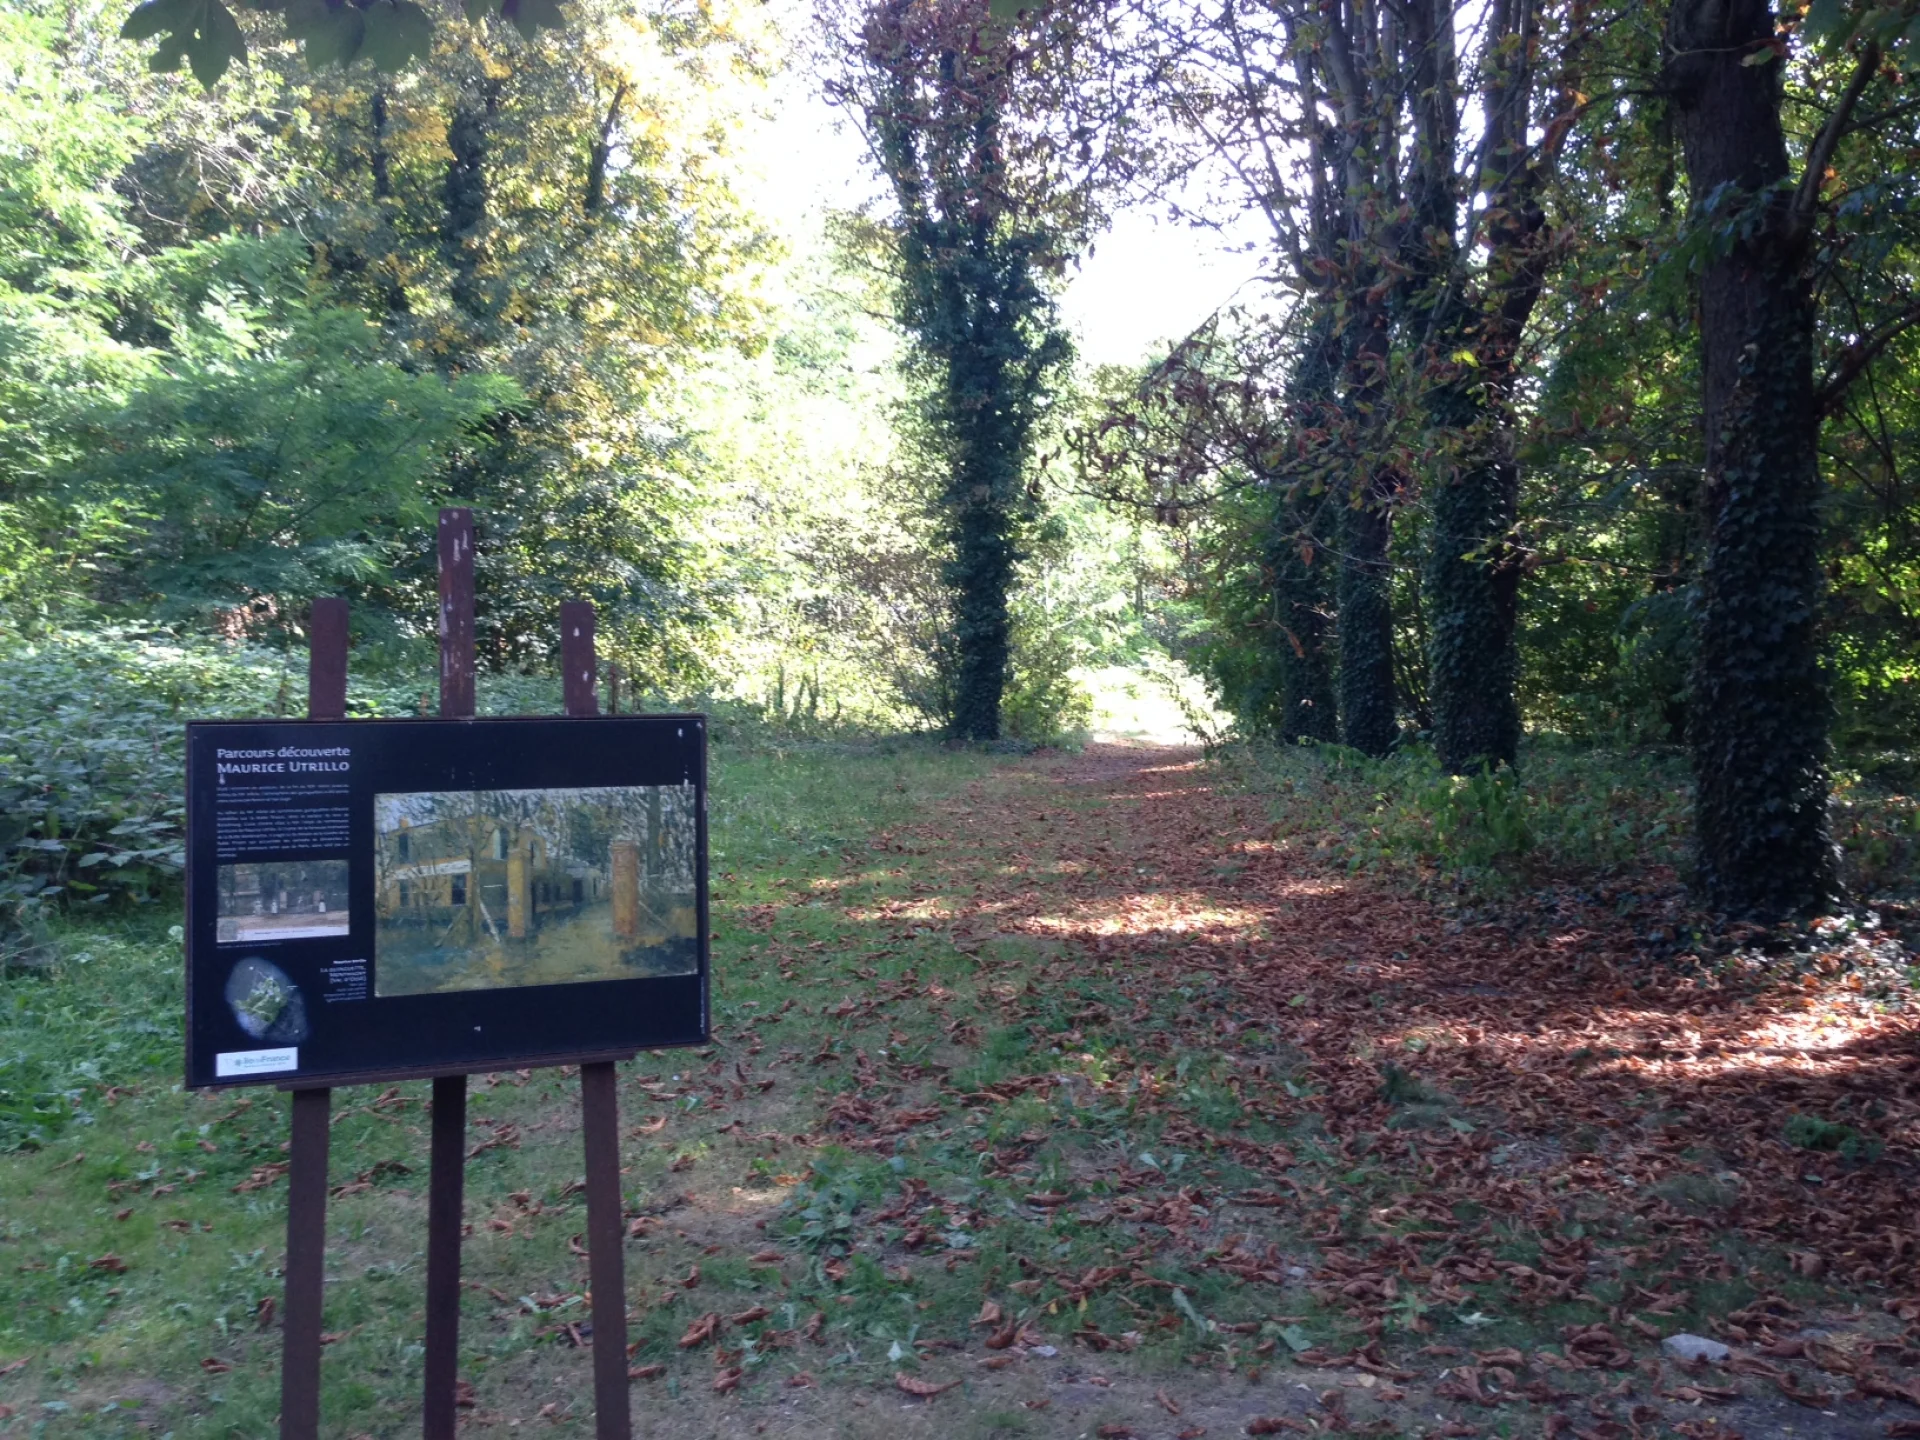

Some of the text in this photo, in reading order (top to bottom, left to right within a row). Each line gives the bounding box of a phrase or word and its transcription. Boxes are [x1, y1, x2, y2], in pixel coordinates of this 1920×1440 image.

[217, 746, 350, 759] Parcours découverte
[217, 761, 350, 774] MAURICE UTRILLO
